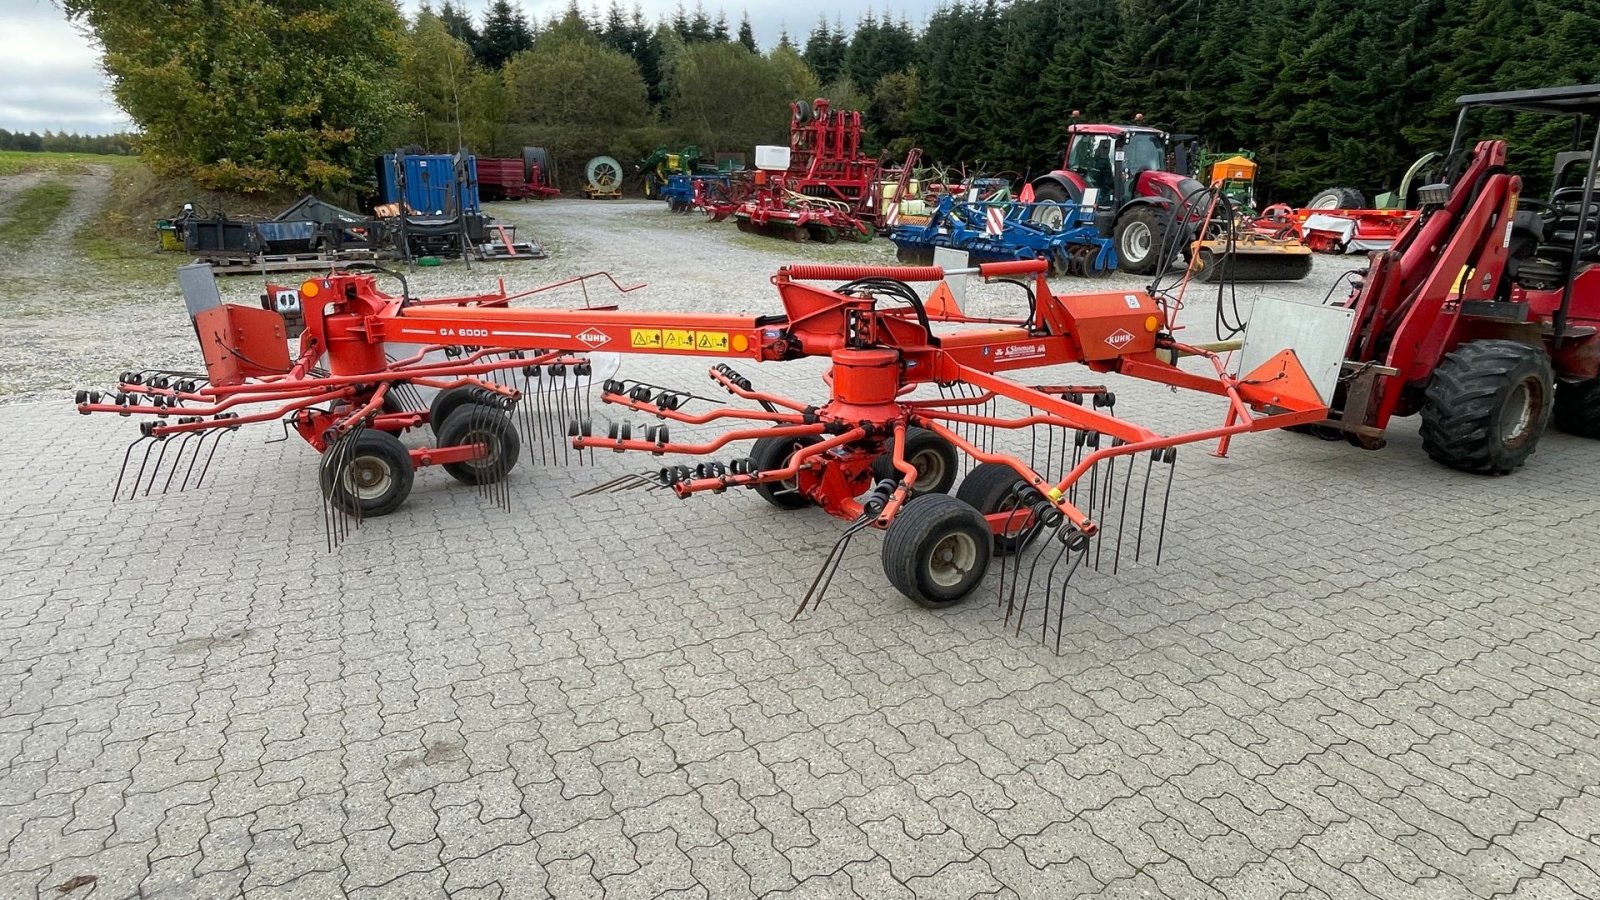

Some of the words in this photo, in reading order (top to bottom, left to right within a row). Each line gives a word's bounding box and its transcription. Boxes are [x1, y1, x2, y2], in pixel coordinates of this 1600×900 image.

[440, 328, 455, 336] GA
[458, 328, 488, 337] 6000
[581, 333, 606, 343] KUHN
[1108, 334, 1131, 344] KUHN
